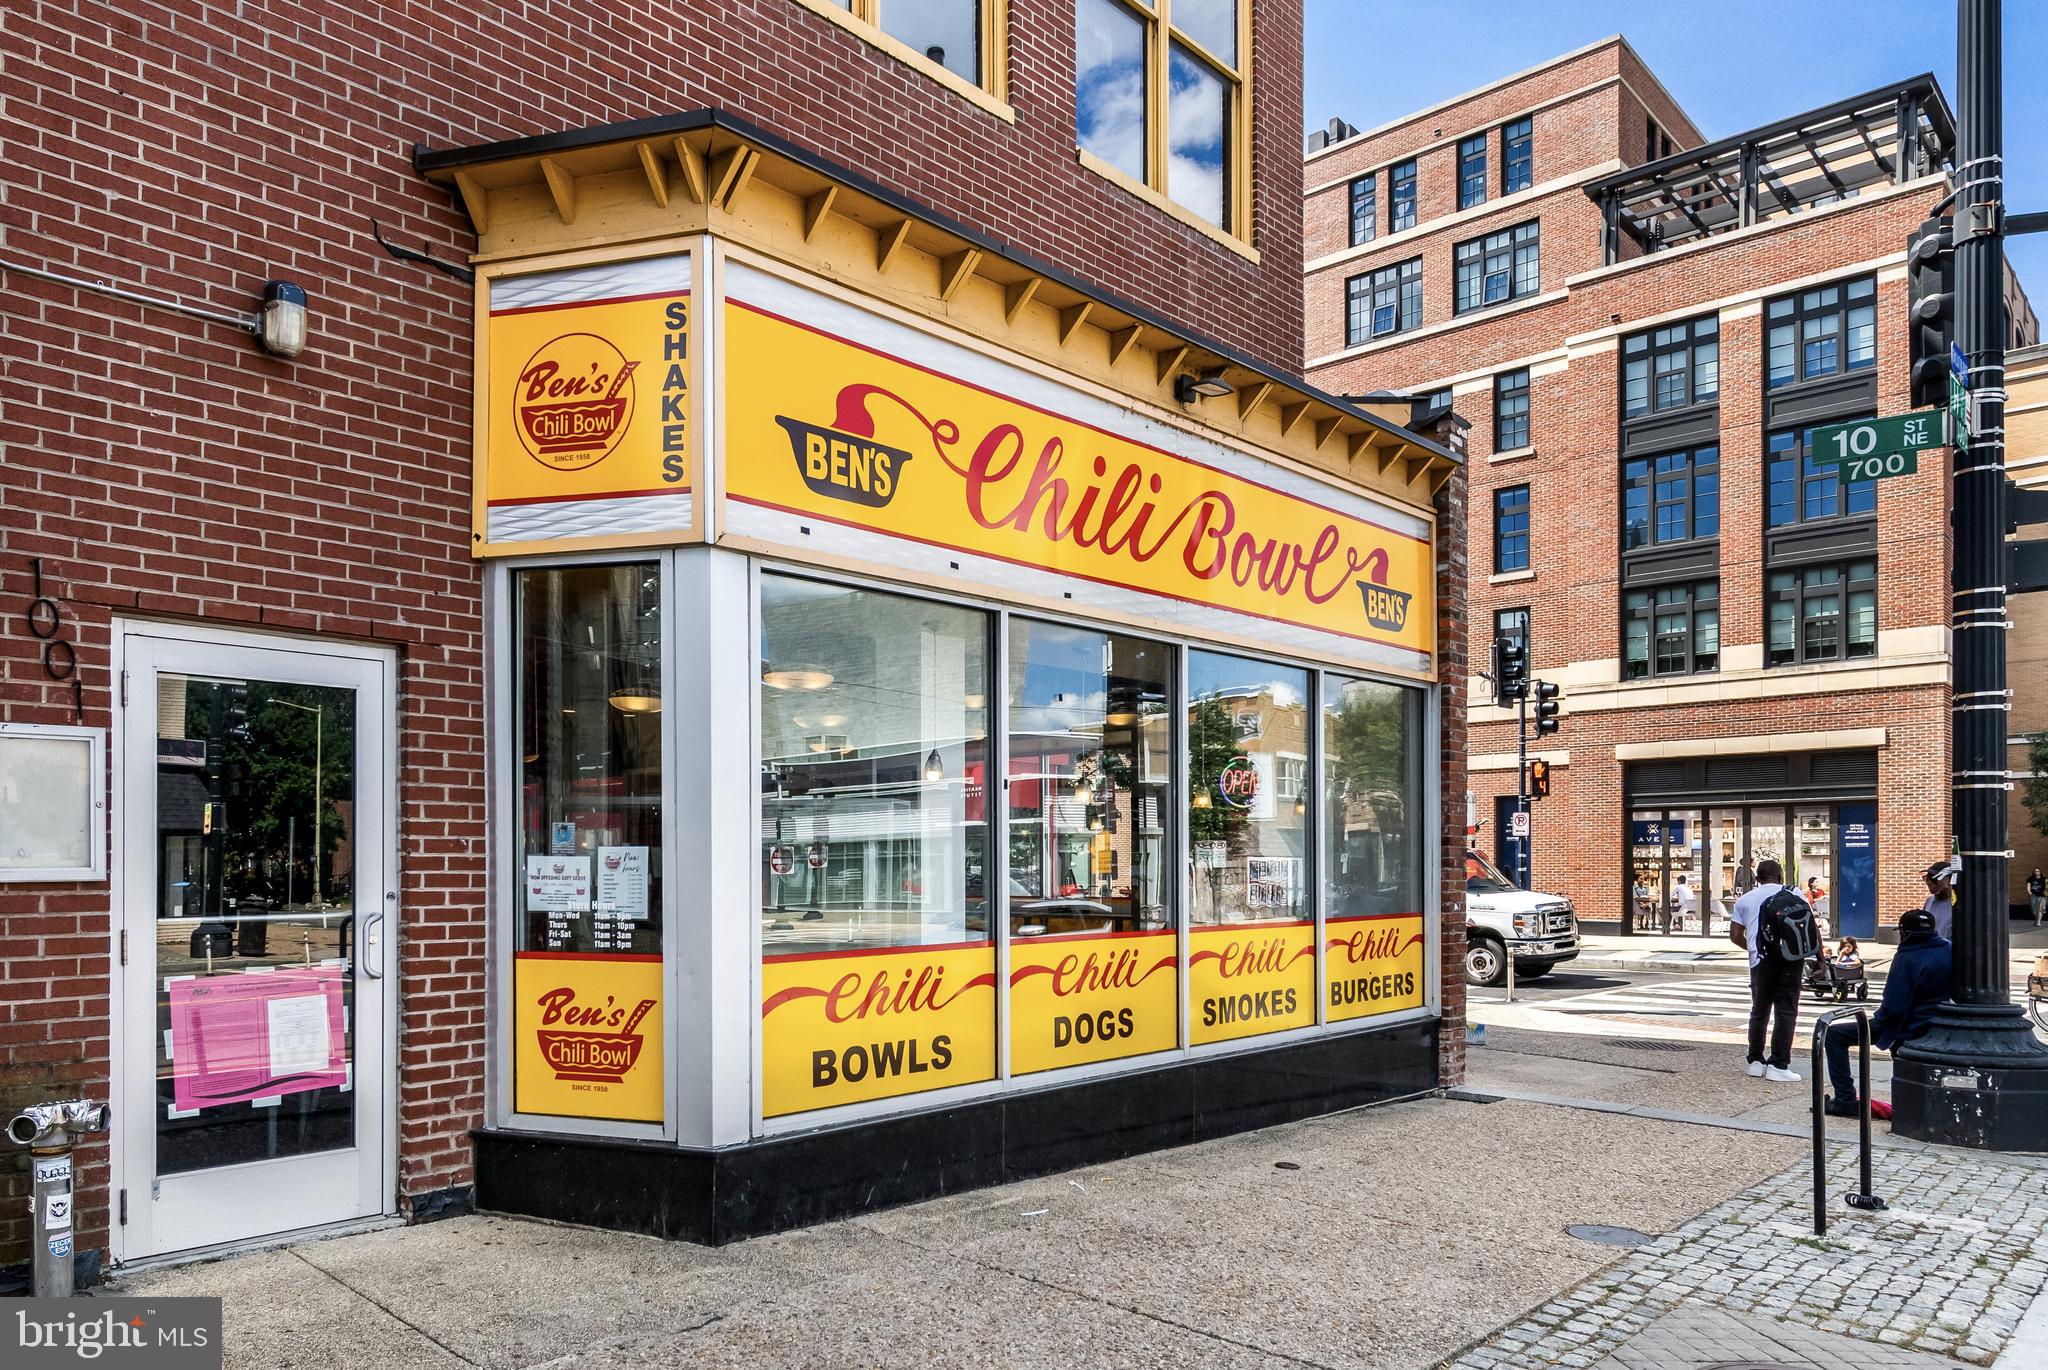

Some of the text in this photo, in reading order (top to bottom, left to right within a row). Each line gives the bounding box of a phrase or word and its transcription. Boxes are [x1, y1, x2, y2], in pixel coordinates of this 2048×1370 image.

[521, 360, 609, 401] Ben's
[661, 302, 687, 482] SHAKES
[532, 410, 615, 437] Chili Bowl
[1832, 418, 1926, 457] 10 ST
[1903, 431, 1928, 447] NE
[554, 453, 591, 463] SINCE 1958
[805, 432, 893, 496] BEN'S
[1848, 454, 1905, 481] 700
[966, 423, 1347, 604] Chili Bowl
[1368, 589, 1405, 625] BEN'S
[567, 900, 616, 910] Store Hours
[548, 930, 572, 938] Fri-Sat
[594, 931, 610, 939] 11am
[548, 939, 562, 947] Sun
[594, 940, 610, 948] 11am
[617, 940, 632, 949] 9pm
[617, 922, 635, 931] 10pm
[1347, 926, 1401, 963] Chili
[1052, 948, 1139, 998] Chili
[1218, 937, 1287, 979] Chili
[537, 987, 626, 1027] Ben's
[824, 965, 946, 1024] Chili
[1330, 971, 1415, 1006] BURGERS
[1202, 987, 1297, 1028] SMOKES
[1054, 1007, 1134, 1048] DOGS
[548, 1042, 631, 1066] Chili Bowl
[812, 1034, 953, 1088] BOWLS
[571, 1084, 608, 1093] SINCE 1958
